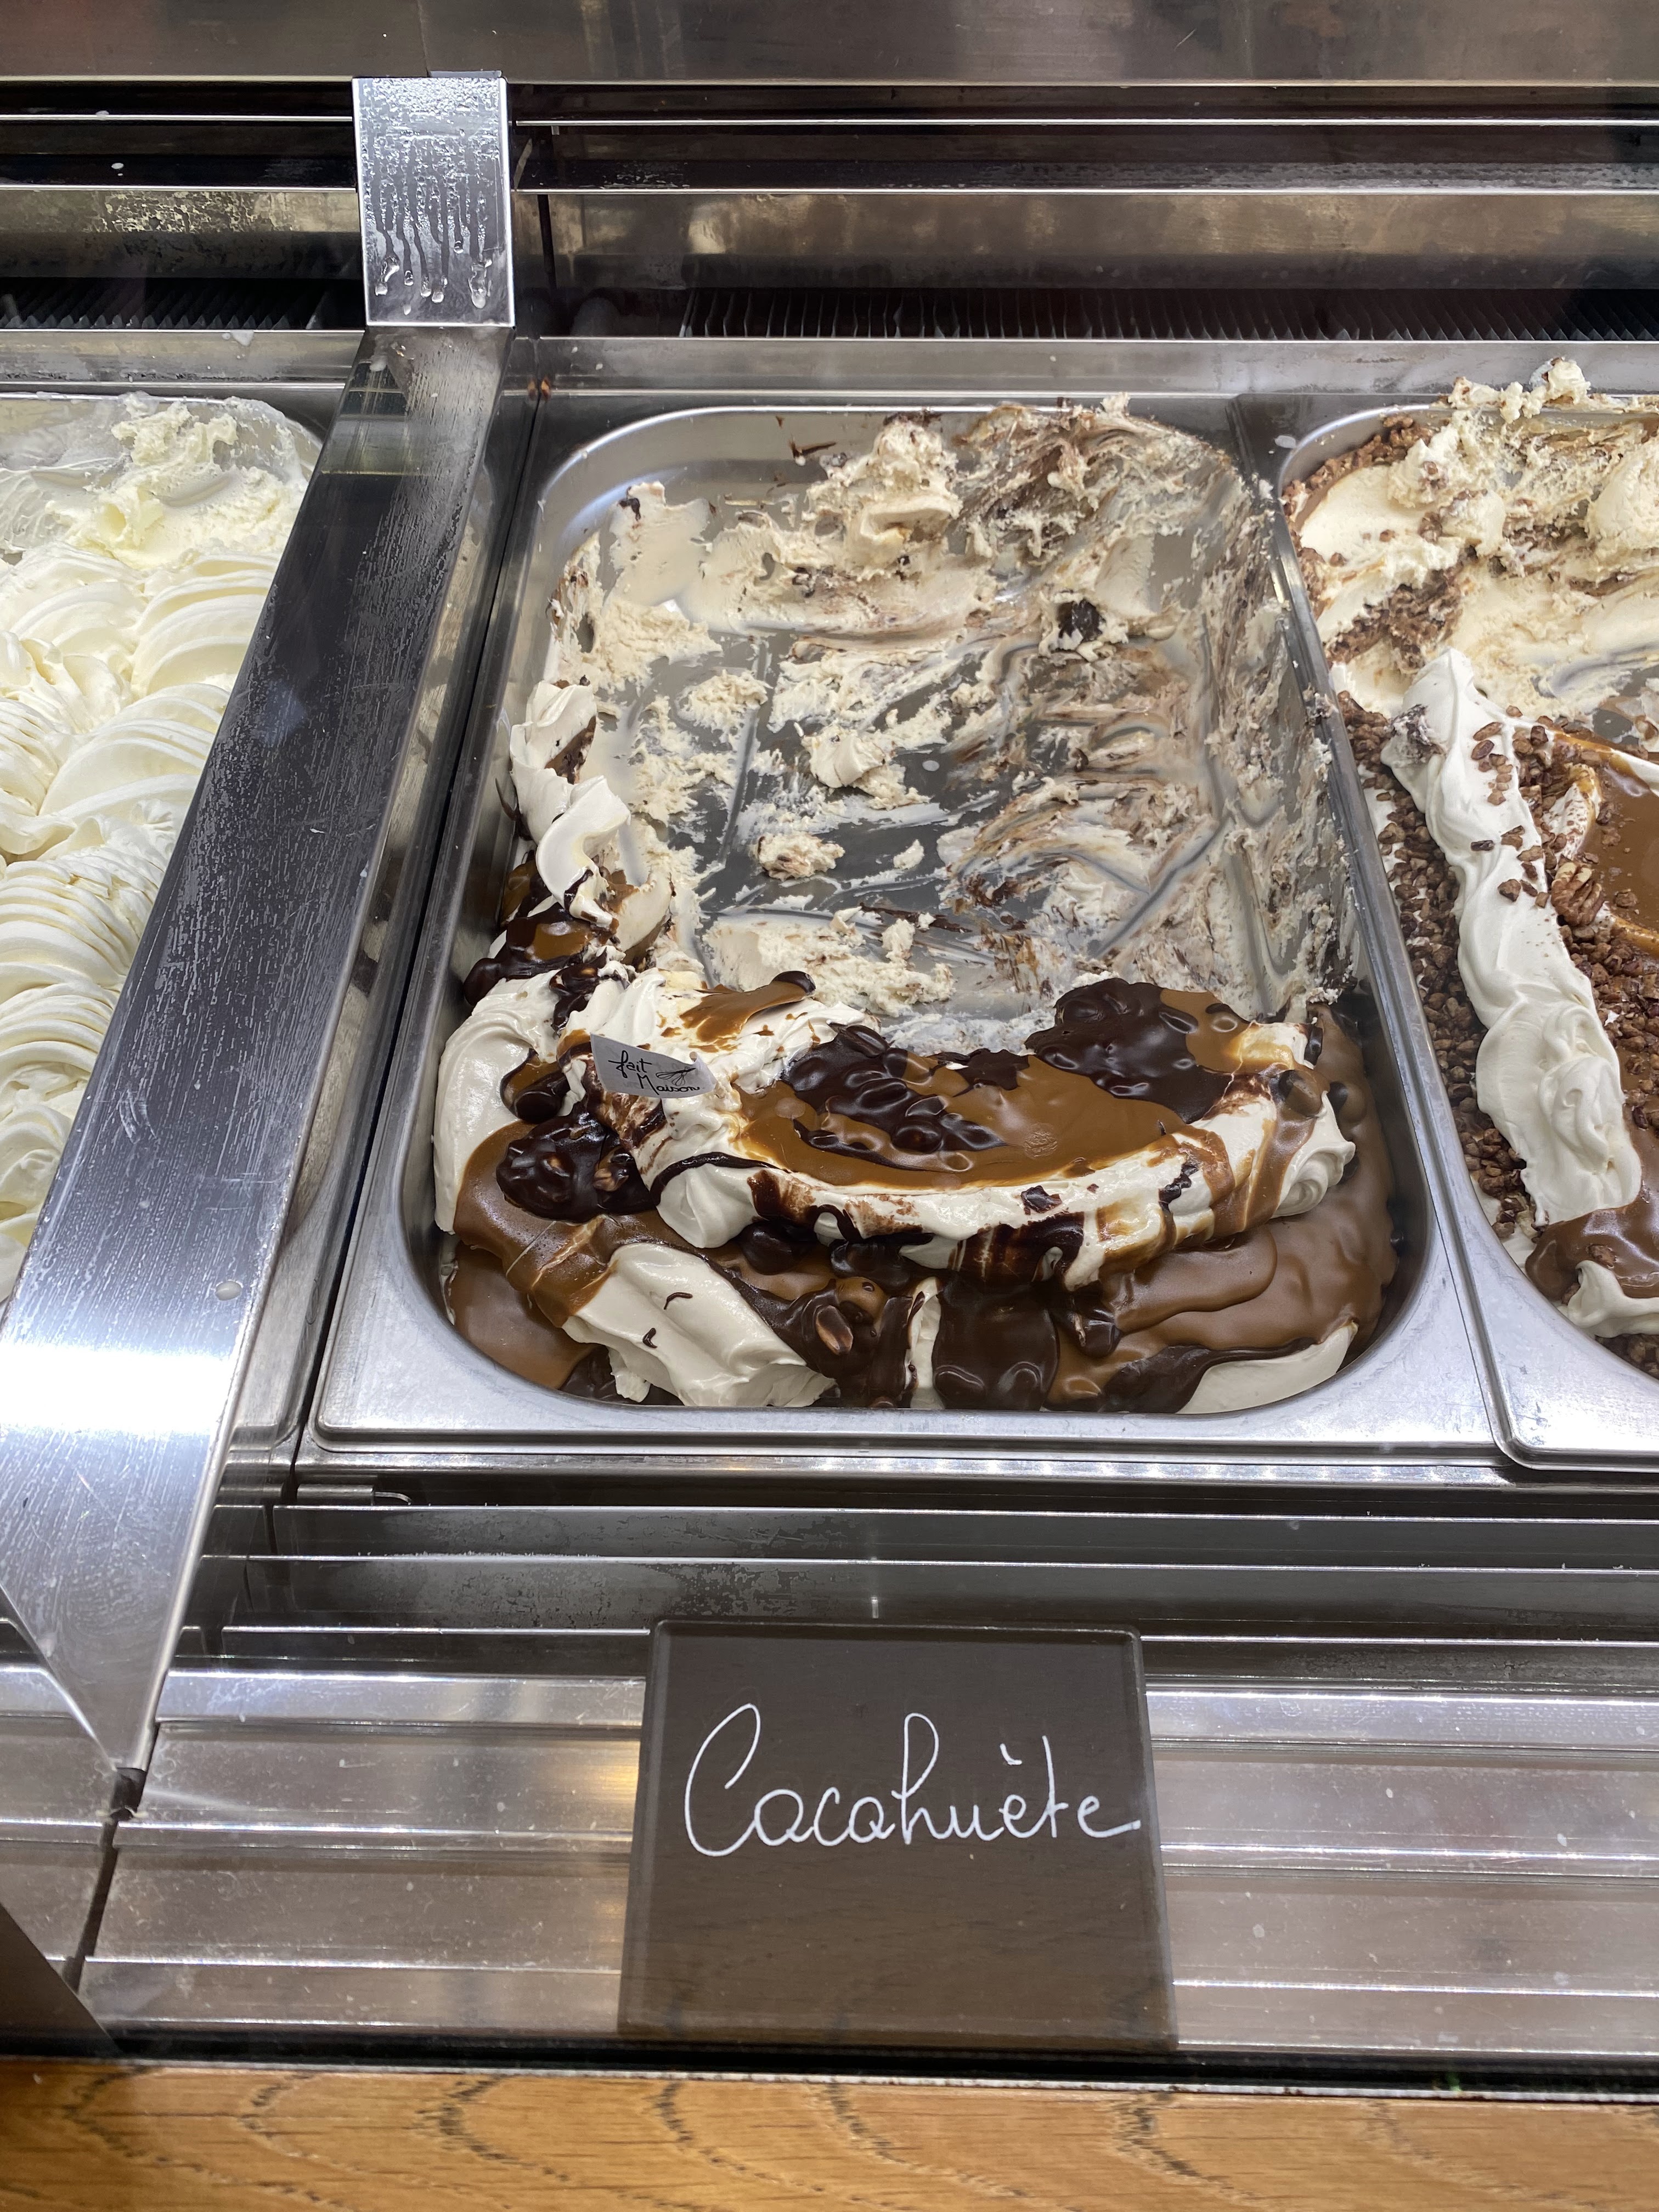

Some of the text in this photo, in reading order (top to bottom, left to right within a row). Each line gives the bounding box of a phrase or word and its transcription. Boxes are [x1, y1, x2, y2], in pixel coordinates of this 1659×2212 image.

[608, 1049, 652, 1079] fait
[636, 1073, 701, 1096] Maison
[684, 1702, 1141, 1858] Cacahuète
